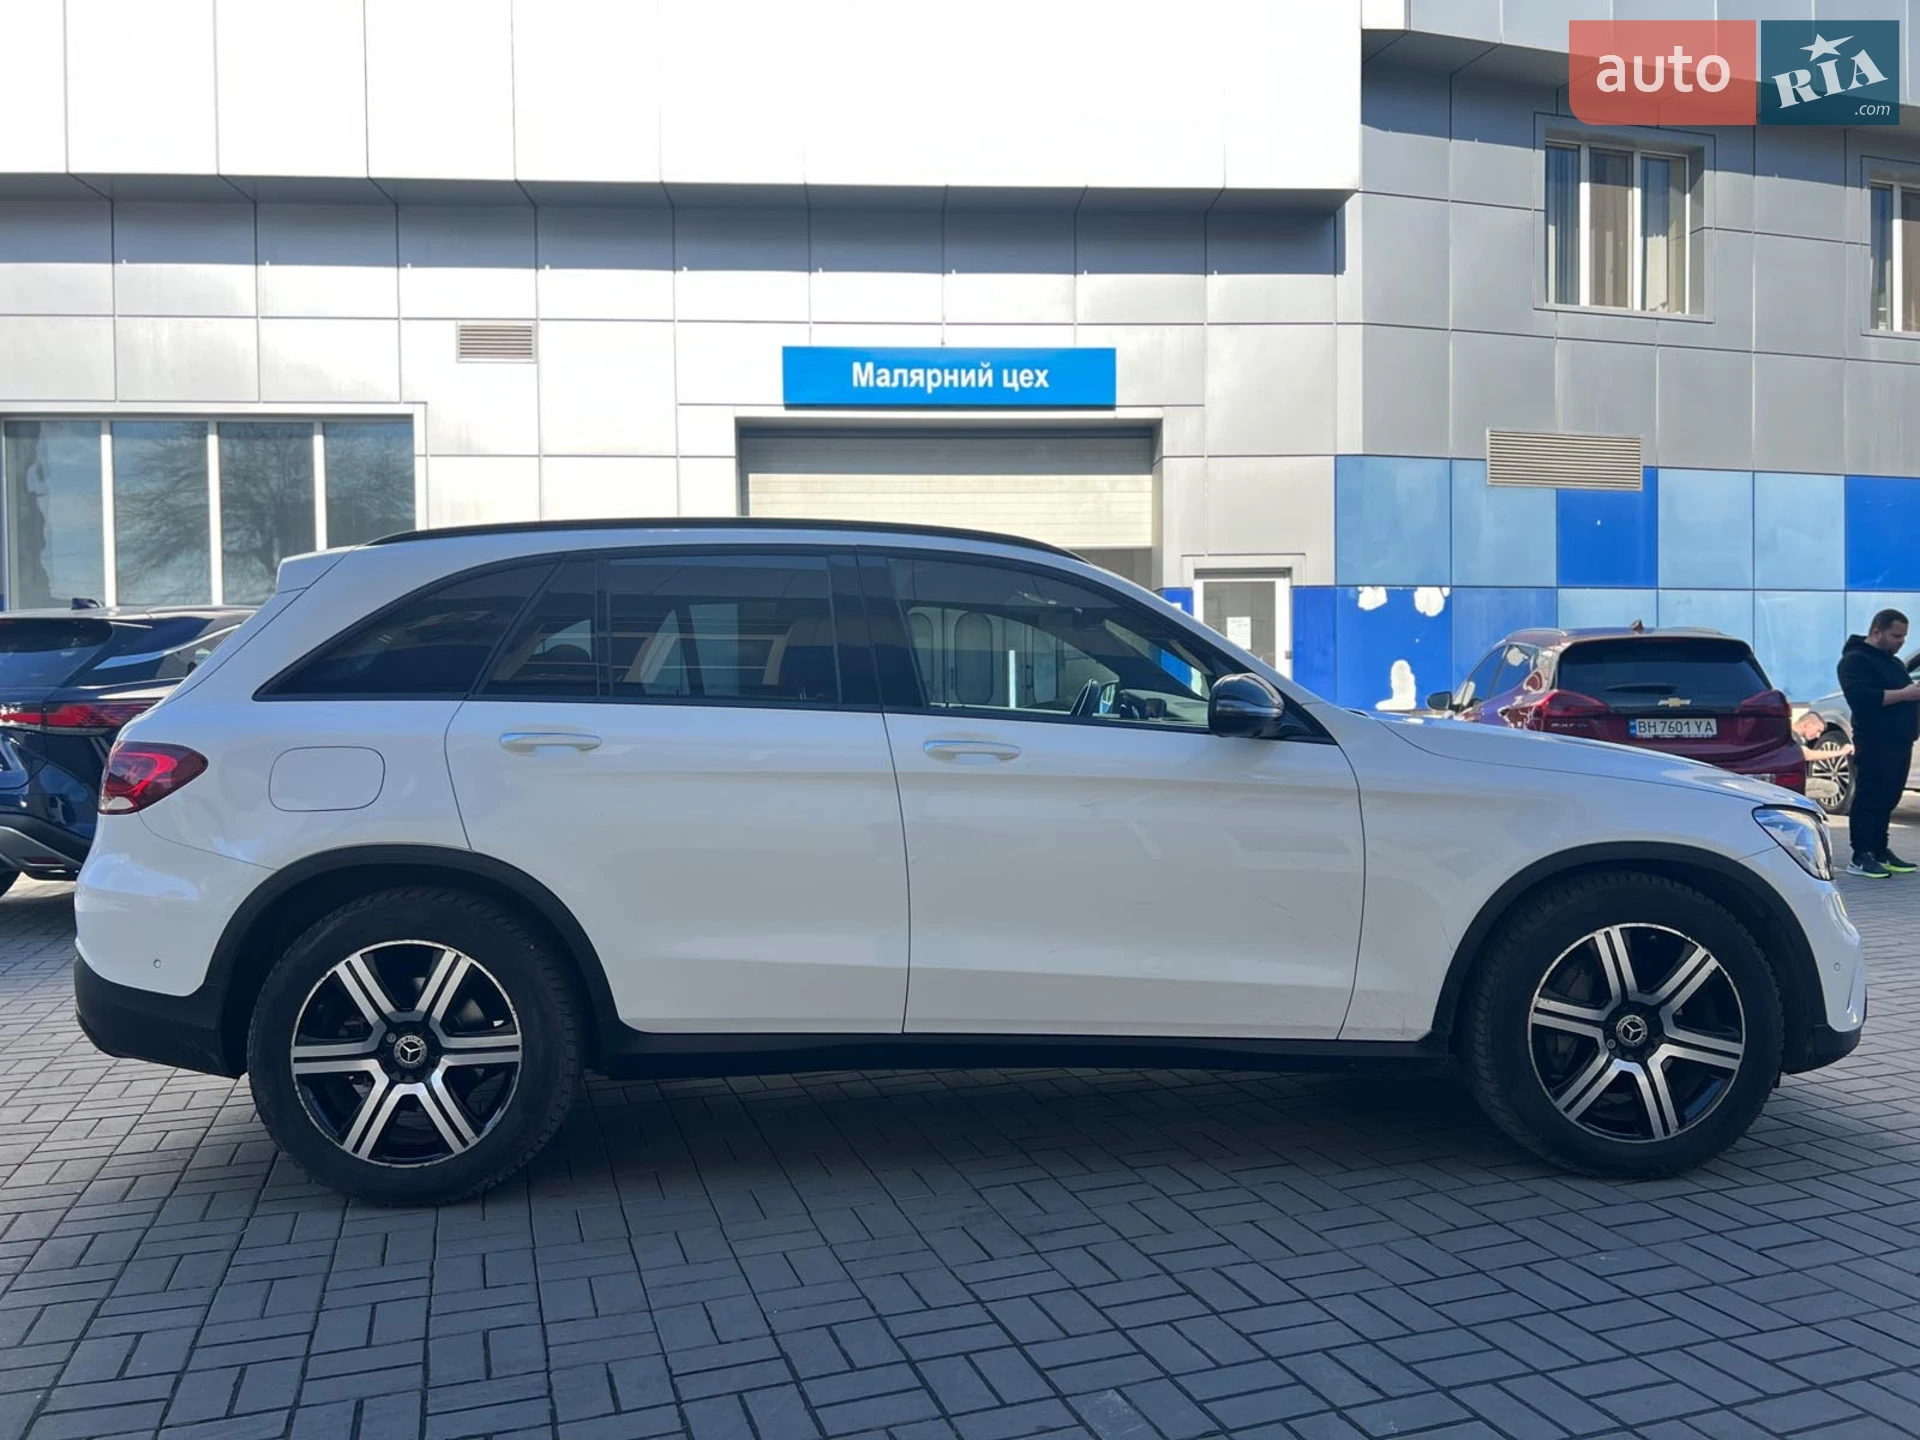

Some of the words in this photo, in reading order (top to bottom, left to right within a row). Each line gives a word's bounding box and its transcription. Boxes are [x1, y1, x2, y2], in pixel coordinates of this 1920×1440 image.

[852, 361, 993, 393] Малярний
[1002, 369, 1049, 392] цех
[1638, 720, 1657, 733] BH
[1659, 720, 1691, 733] 7601
